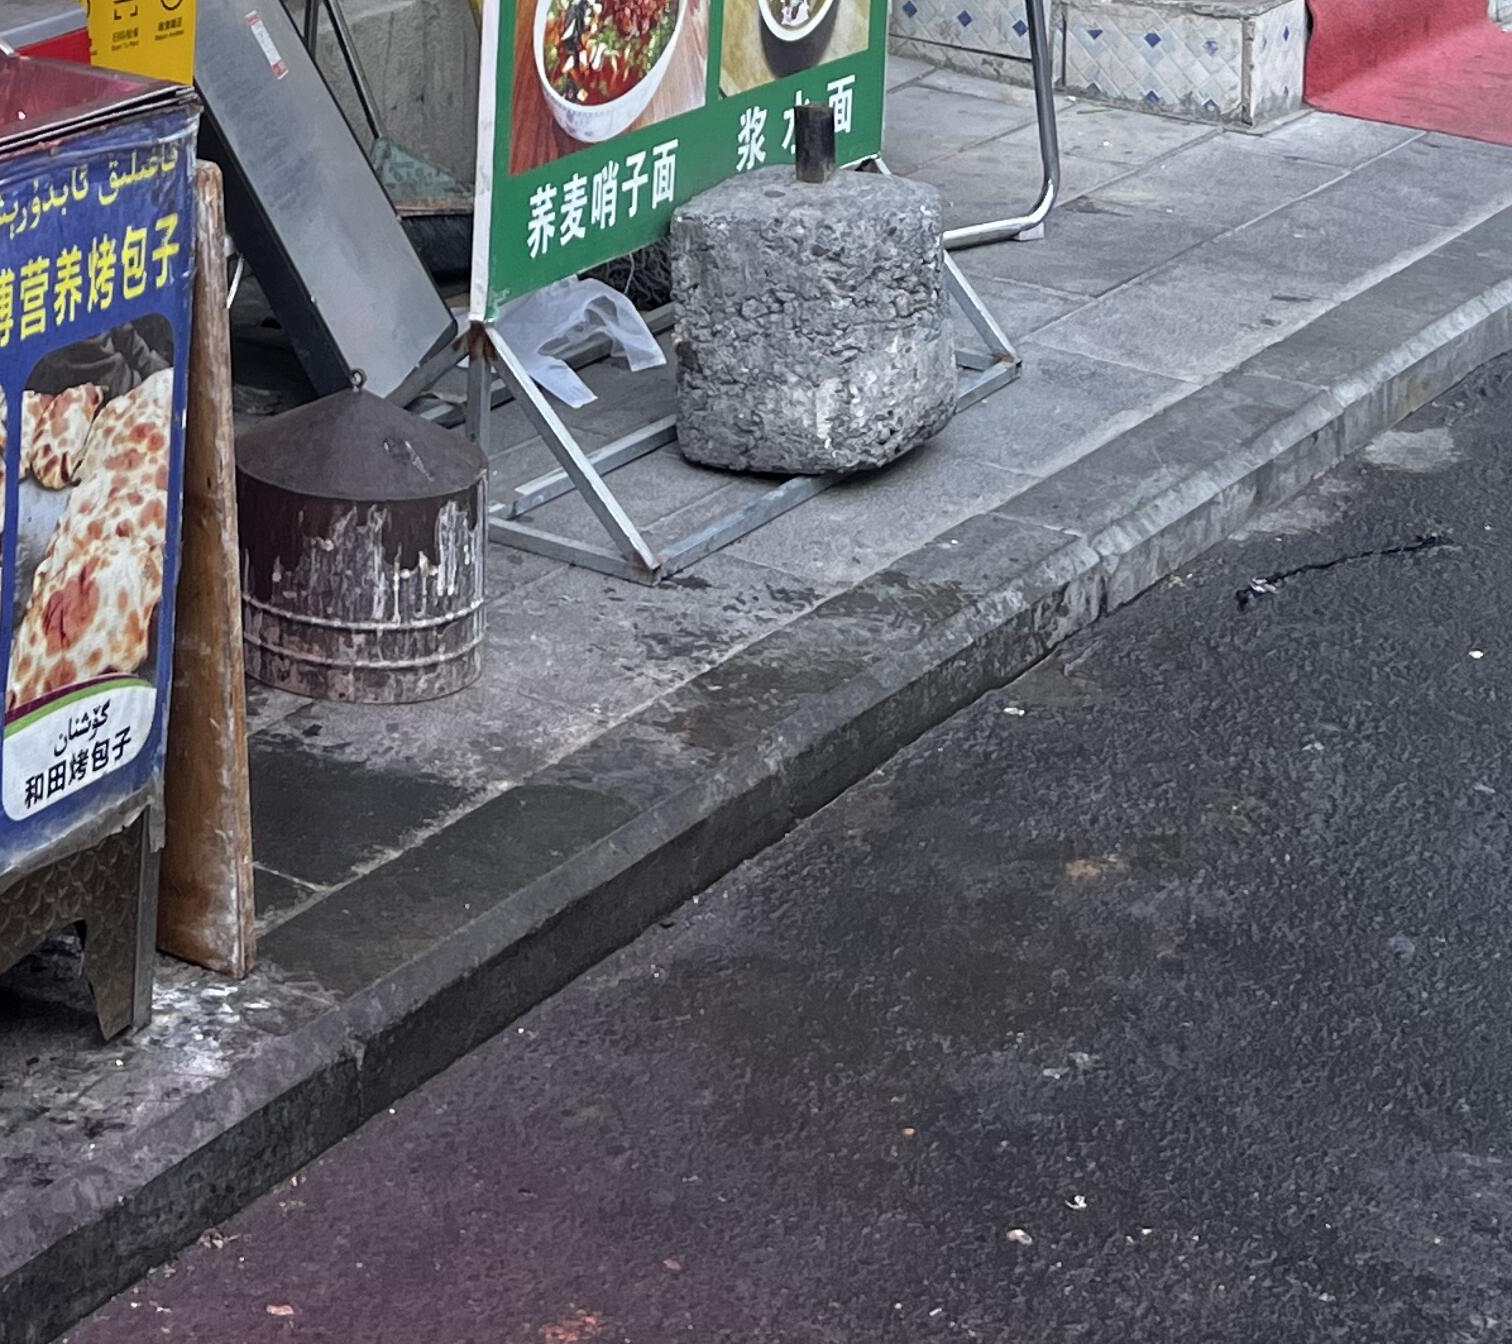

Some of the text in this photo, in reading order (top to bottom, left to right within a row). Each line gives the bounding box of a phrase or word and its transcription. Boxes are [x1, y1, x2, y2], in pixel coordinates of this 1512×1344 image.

[527, 139, 678, 259] 荞麦哨子面
[24, 726, 132, 809] 和田烤包子
